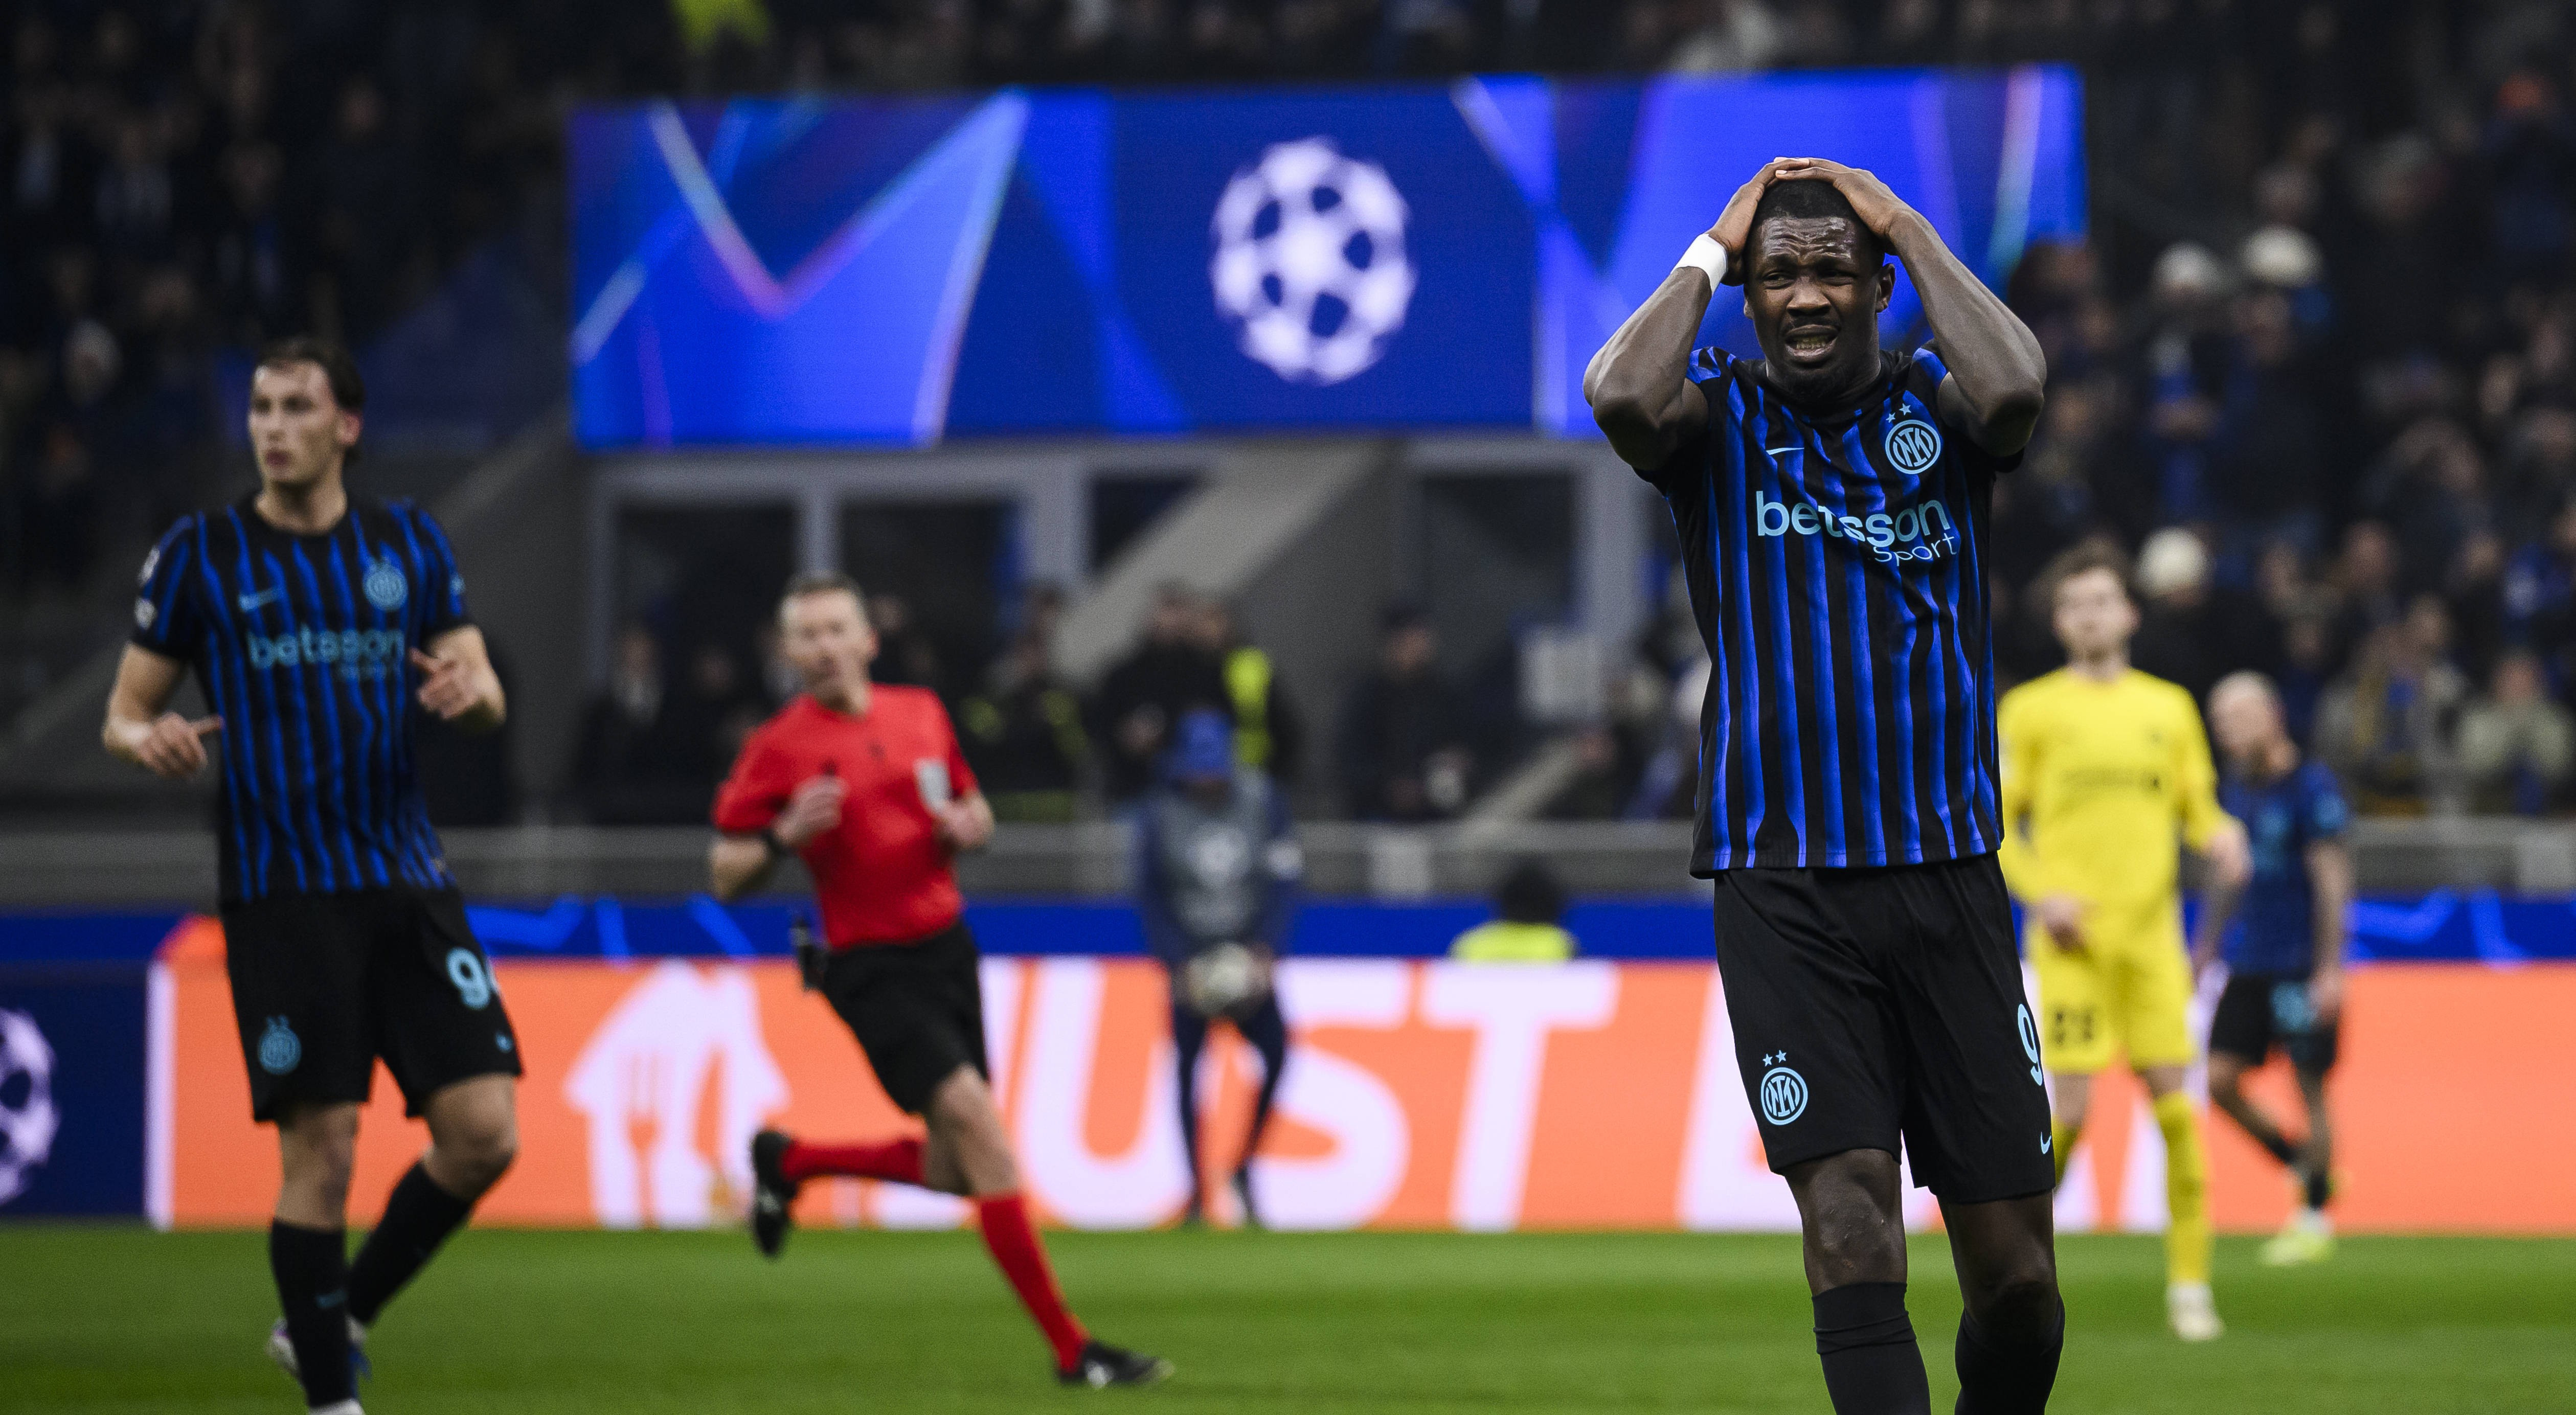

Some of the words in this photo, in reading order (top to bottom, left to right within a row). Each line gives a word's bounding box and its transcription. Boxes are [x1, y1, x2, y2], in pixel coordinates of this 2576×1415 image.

[1756, 491, 1951, 547] betsson
[445, 946, 501, 1010] 9
[2017, 1003, 2043, 1086] 9
